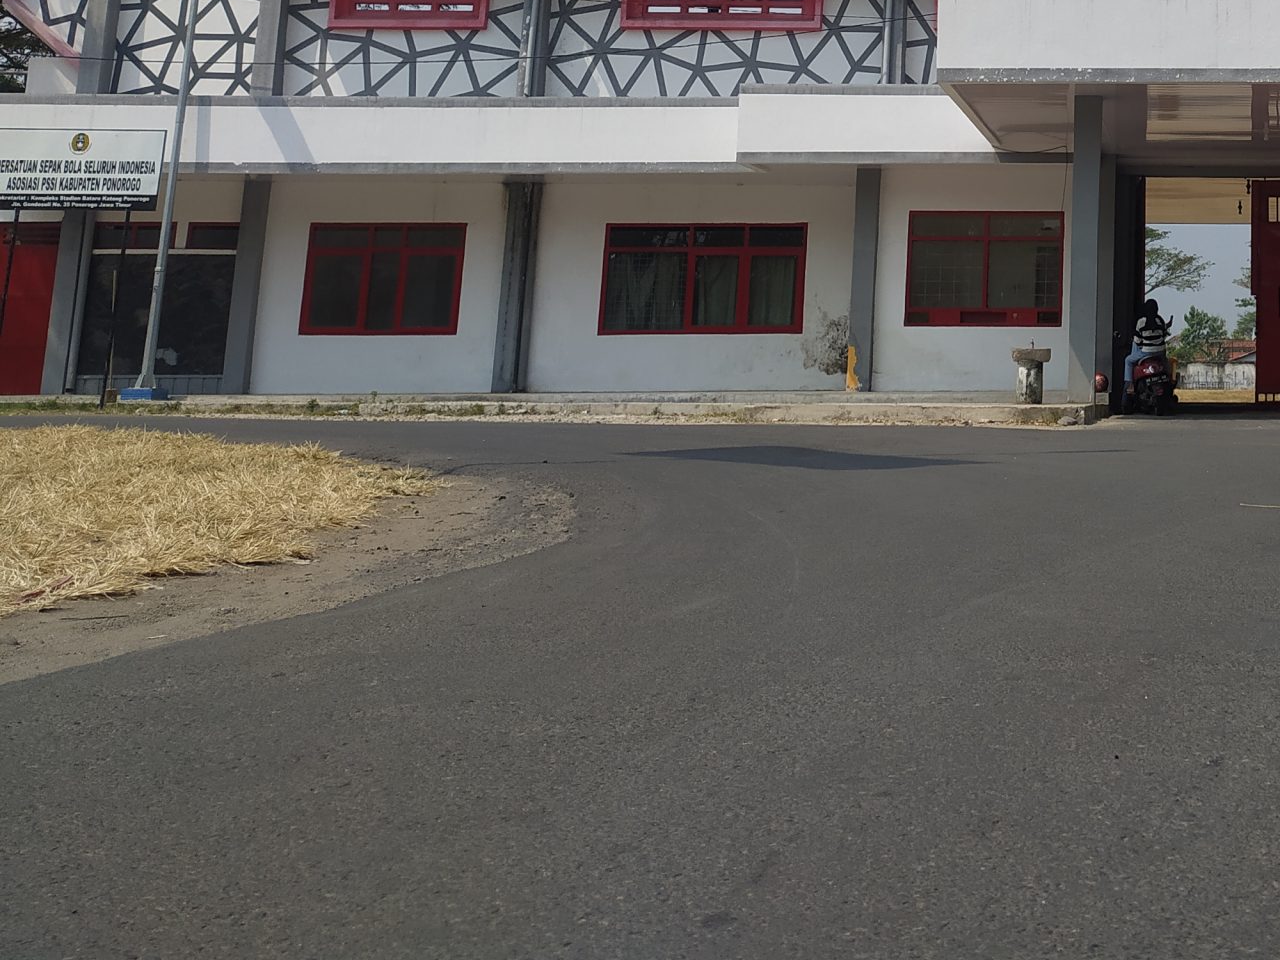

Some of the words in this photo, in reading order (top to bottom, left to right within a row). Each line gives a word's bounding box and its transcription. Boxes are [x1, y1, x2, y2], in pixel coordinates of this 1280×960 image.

[39, 160, 63, 174] SEPAK
[63, 160, 82, 174] BOLA
[83, 160, 117, 174] SELURUH
[117, 161, 156, 175] INDONESIA
[6, 177, 40, 191] ASOSIASI
[41, 177, 58, 191] PSSI
[58, 177, 101, 191] KABUPATEN
[102, 177, 141, 191] PONOROGO
